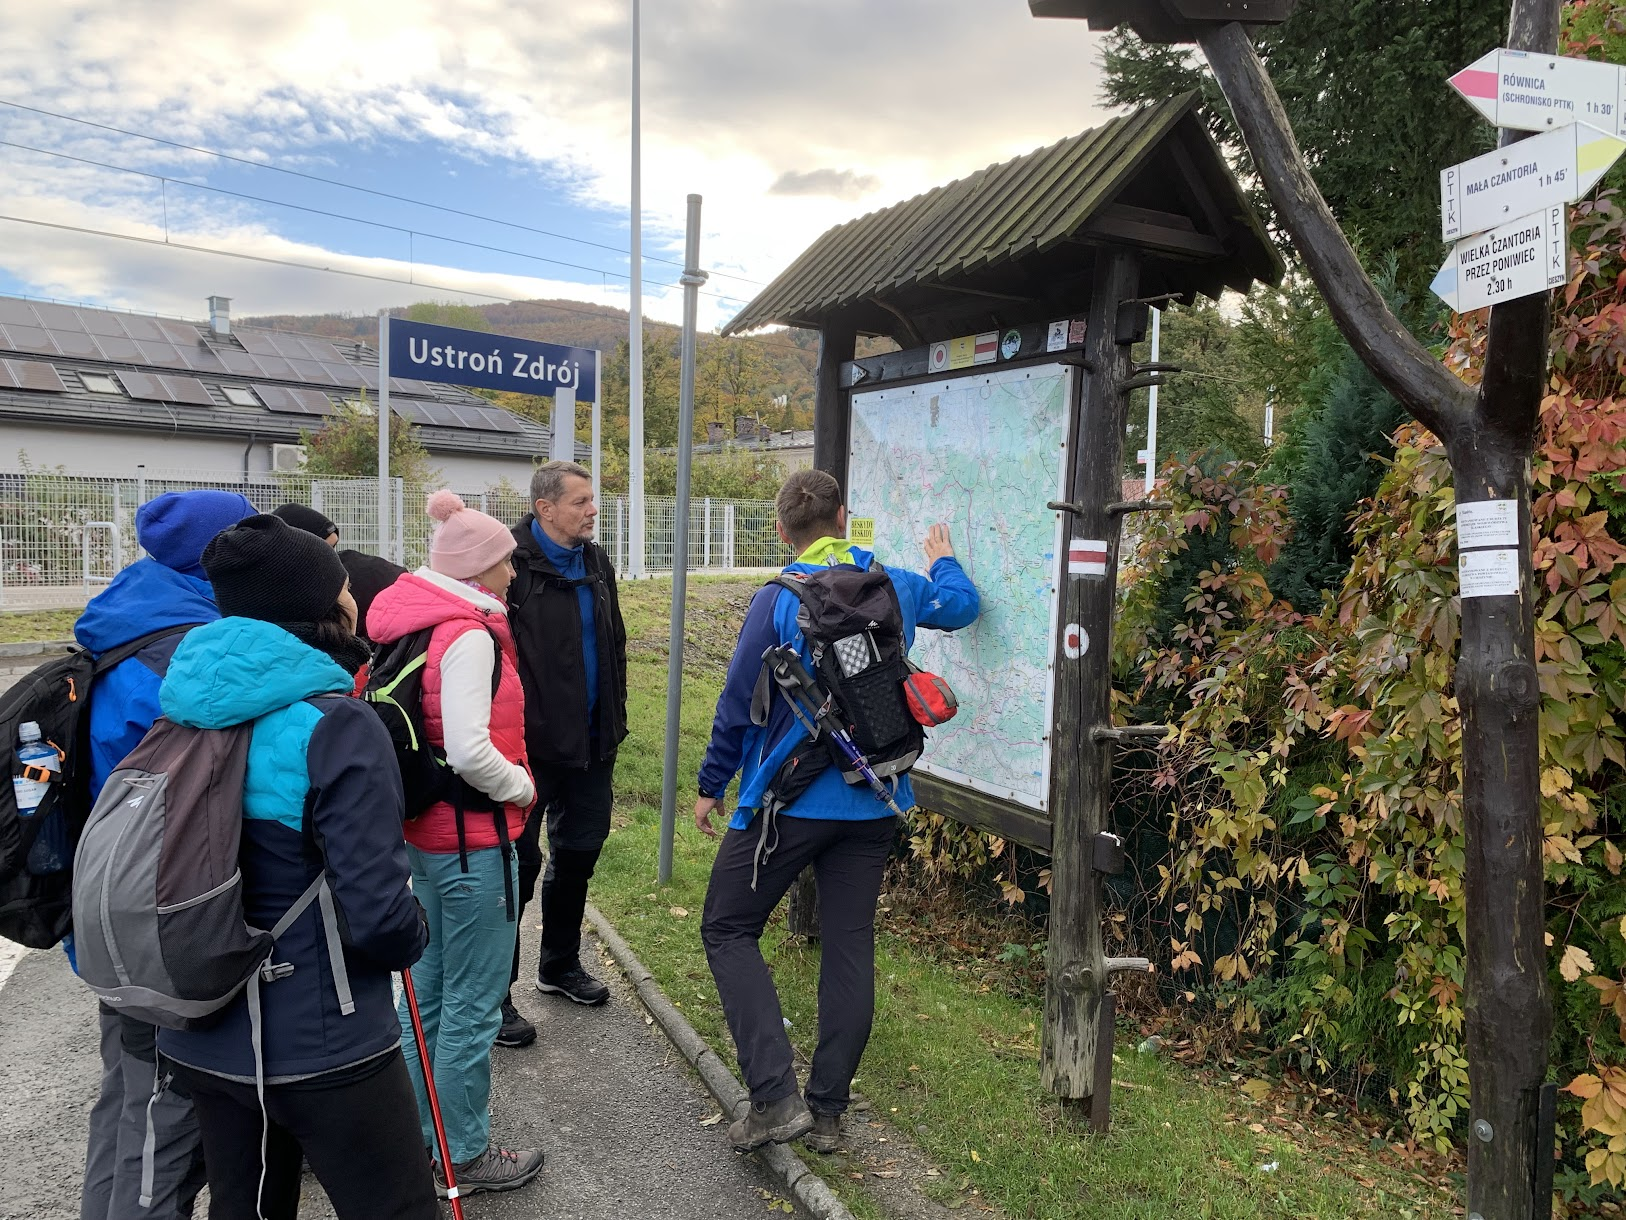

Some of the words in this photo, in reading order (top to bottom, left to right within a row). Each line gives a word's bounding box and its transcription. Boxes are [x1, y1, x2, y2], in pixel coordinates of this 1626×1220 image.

[1503, 73, 1545, 90] RÓWNICA
[1502, 93, 1552, 107] (SCHRONISKO
[1554, 100, 1574, 112] PTTK)
[1586, 102, 1591, 112] 1
[1594, 102, 1598, 113] h
[1466, 178, 1488, 196] MAŁA
[1490, 162, 1538, 187] CZANTORIA
[1538, 176, 1543, 187] 1
[1546, 174, 1552, 185] h
[1460, 244, 1490, 265] WIELKA
[1492, 226, 1541, 254] CZANTORIA
[1466, 263, 1490, 282] PRZEZ
[1492, 248, 1535, 273] PONIWIEC
[1487, 280, 1505, 296] 2.30
[1508, 278, 1512, 289] h
[1548, 274, 1565, 284] CIESZYN
[409, 336, 503, 374] Ustroń
[512, 352, 580, 390] Zdrój
